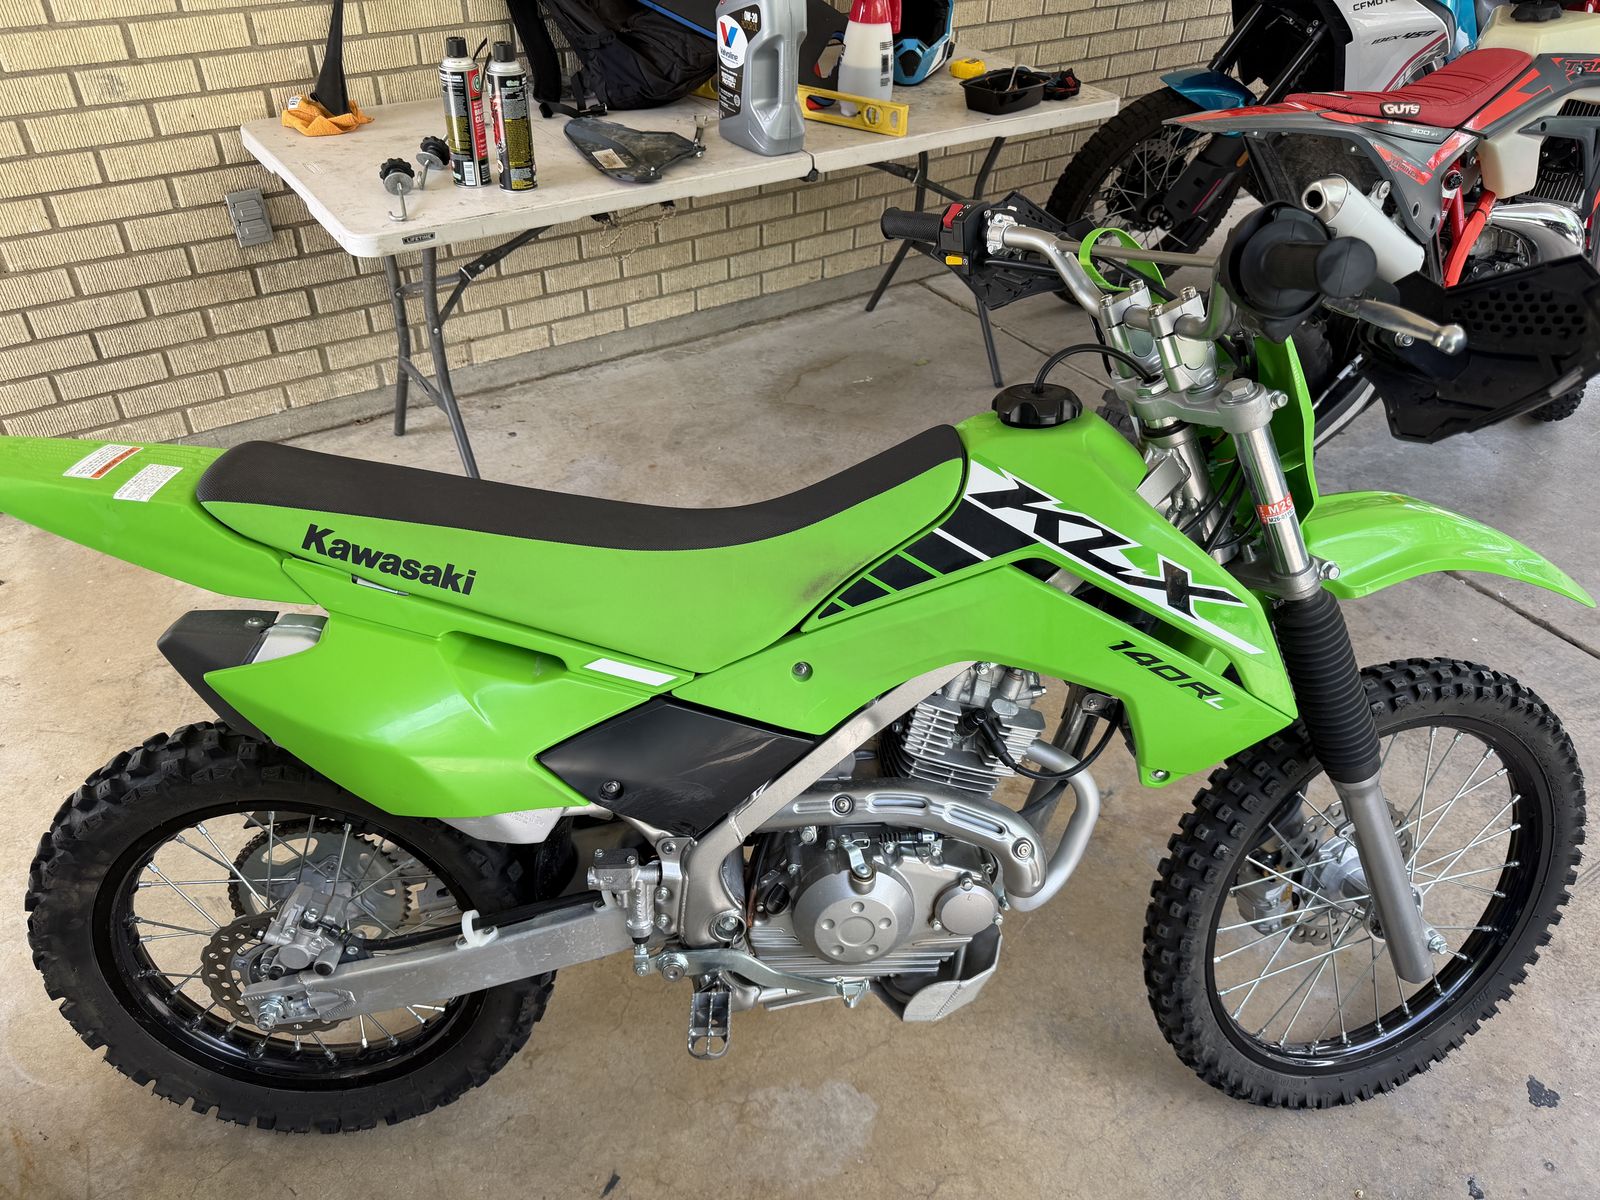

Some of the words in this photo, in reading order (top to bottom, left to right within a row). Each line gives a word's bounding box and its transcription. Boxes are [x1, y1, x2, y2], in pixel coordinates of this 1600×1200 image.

[1352, 0, 1396, 11] CFMO
[1402, 30, 1438, 39] 450
[720, 46, 739, 60] Valvoline
[1383, 103, 1420, 115] GUTS
[1410, 127, 1431, 136] 300
[1268, 496, 1292, 514] M26
[968, 477, 1247, 620] KLX
[301, 523, 477, 596] Kawasaki
